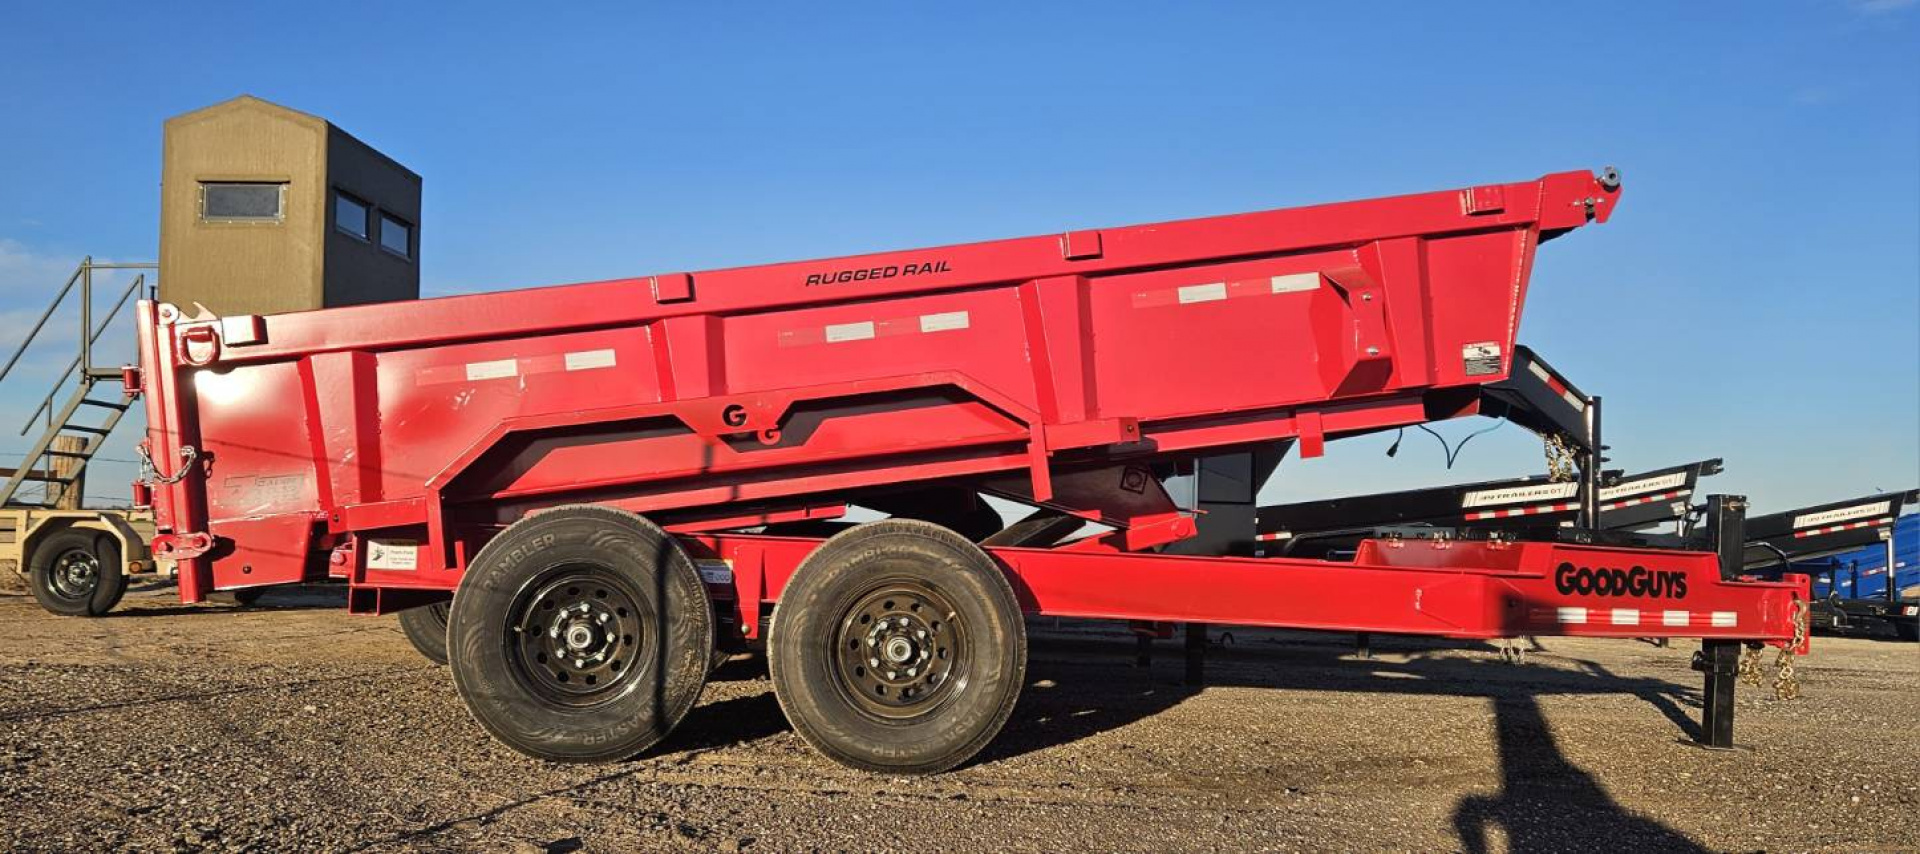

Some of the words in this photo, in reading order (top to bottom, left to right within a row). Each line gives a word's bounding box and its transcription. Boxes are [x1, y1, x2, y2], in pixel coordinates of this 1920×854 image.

[805, 266, 899, 287] RUGGED
[903, 261, 952, 276] RAIL
[722, 404, 747, 427] G
[1497, 488, 1550, 500] TRAILERS
[481, 533, 555, 592] RAMBLER
[1555, 562, 1687, 599] GOODGUYS
